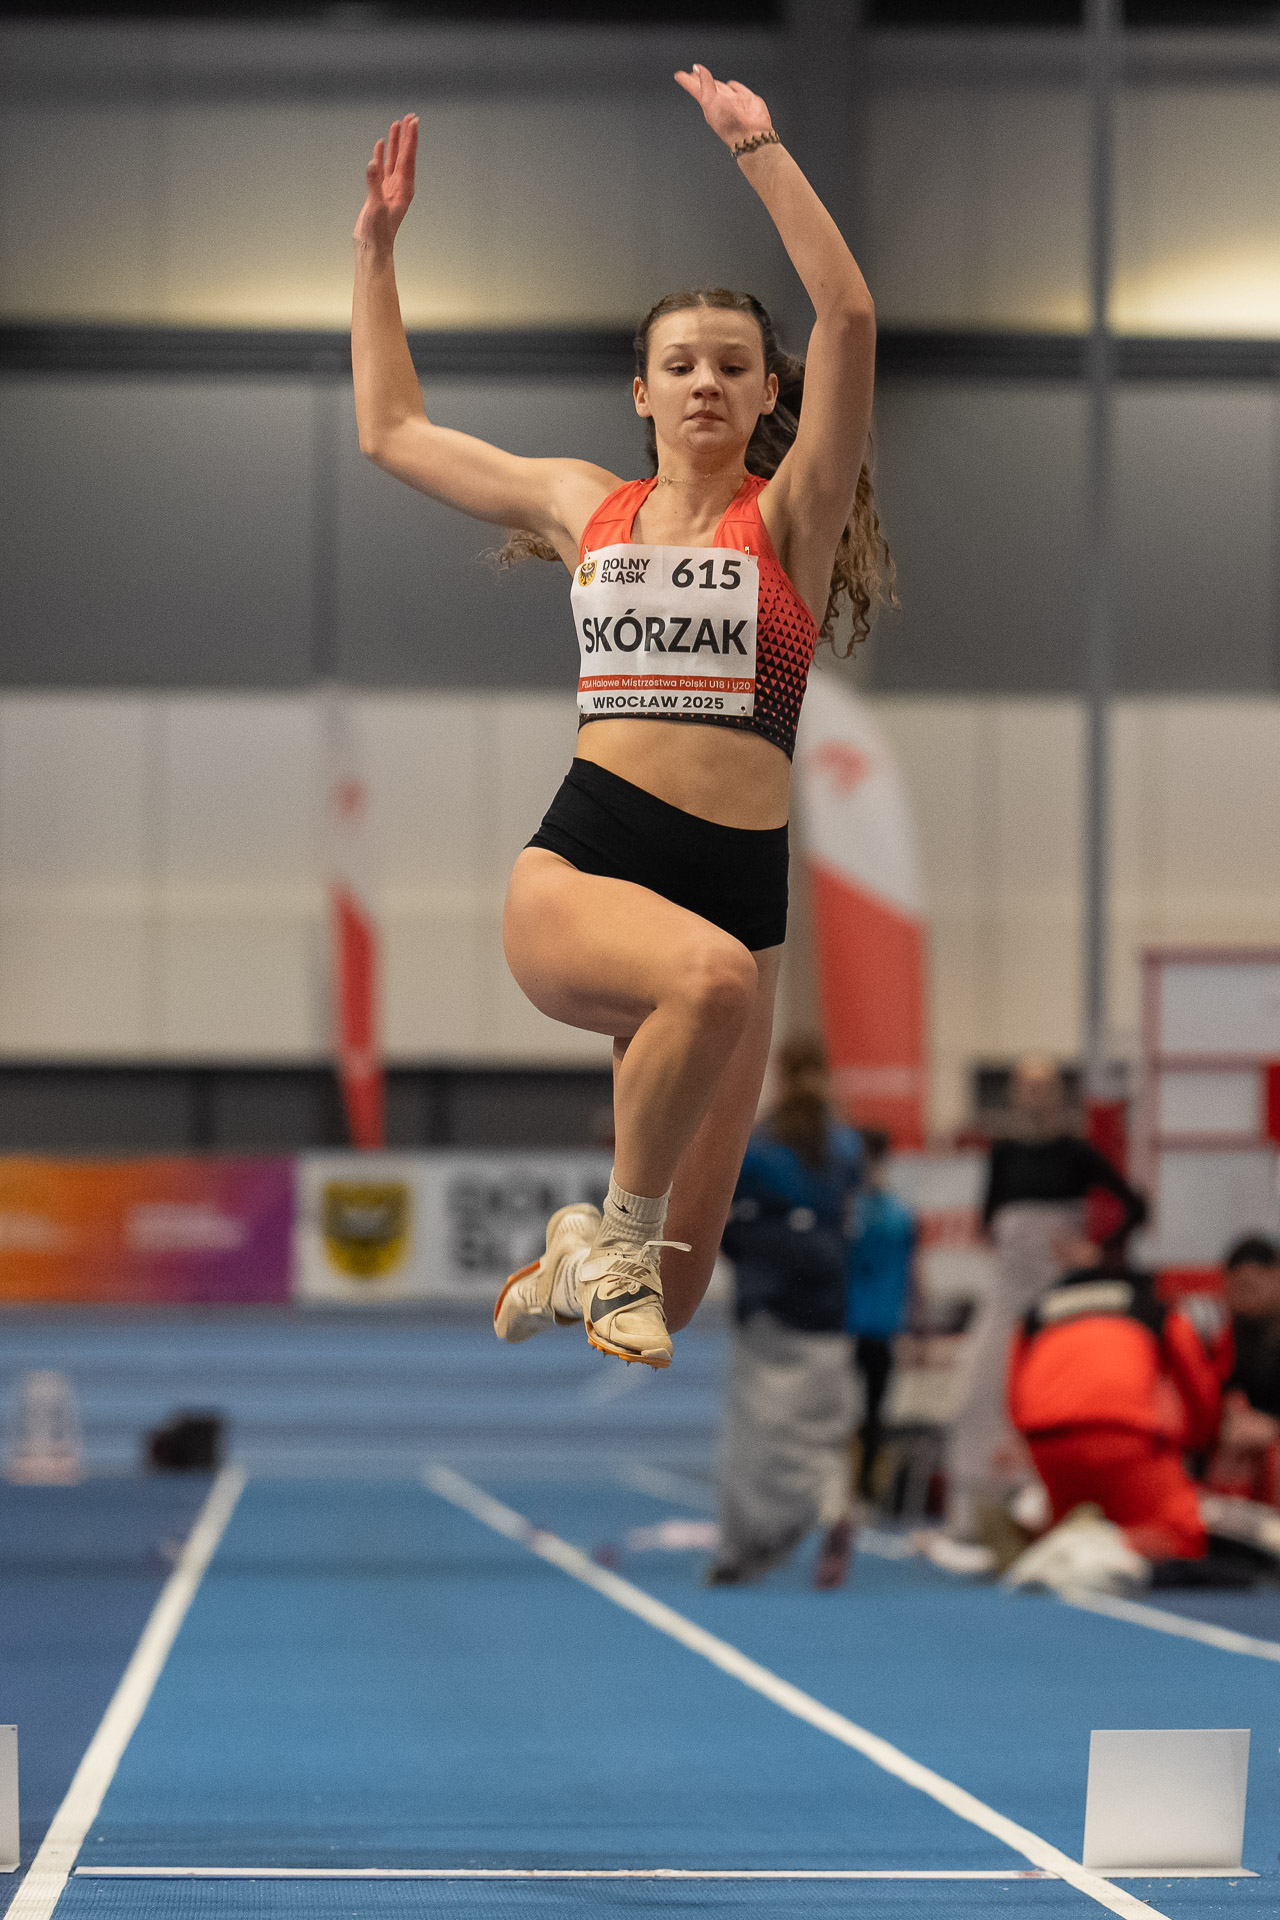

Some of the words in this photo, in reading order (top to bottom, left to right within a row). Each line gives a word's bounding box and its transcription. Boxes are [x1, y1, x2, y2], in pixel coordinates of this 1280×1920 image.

[602, 558, 650, 571] DOLNY
[600, 567, 646, 585] ŚLĄSK
[671, 558, 741, 590] 615
[582, 608, 748, 655] SKÓRZAK
[592, 679, 619, 688] Halowe
[621, 678, 677, 688] Mistrzostwa
[679, 679, 707, 688] Polski
[709, 680, 725, 689] U18
[732, 681, 751, 691] U20
[592, 696, 678, 709] WROCŁAW
[682, 696, 724, 709] 2025
[606, 1259, 652, 1279] NIKE
